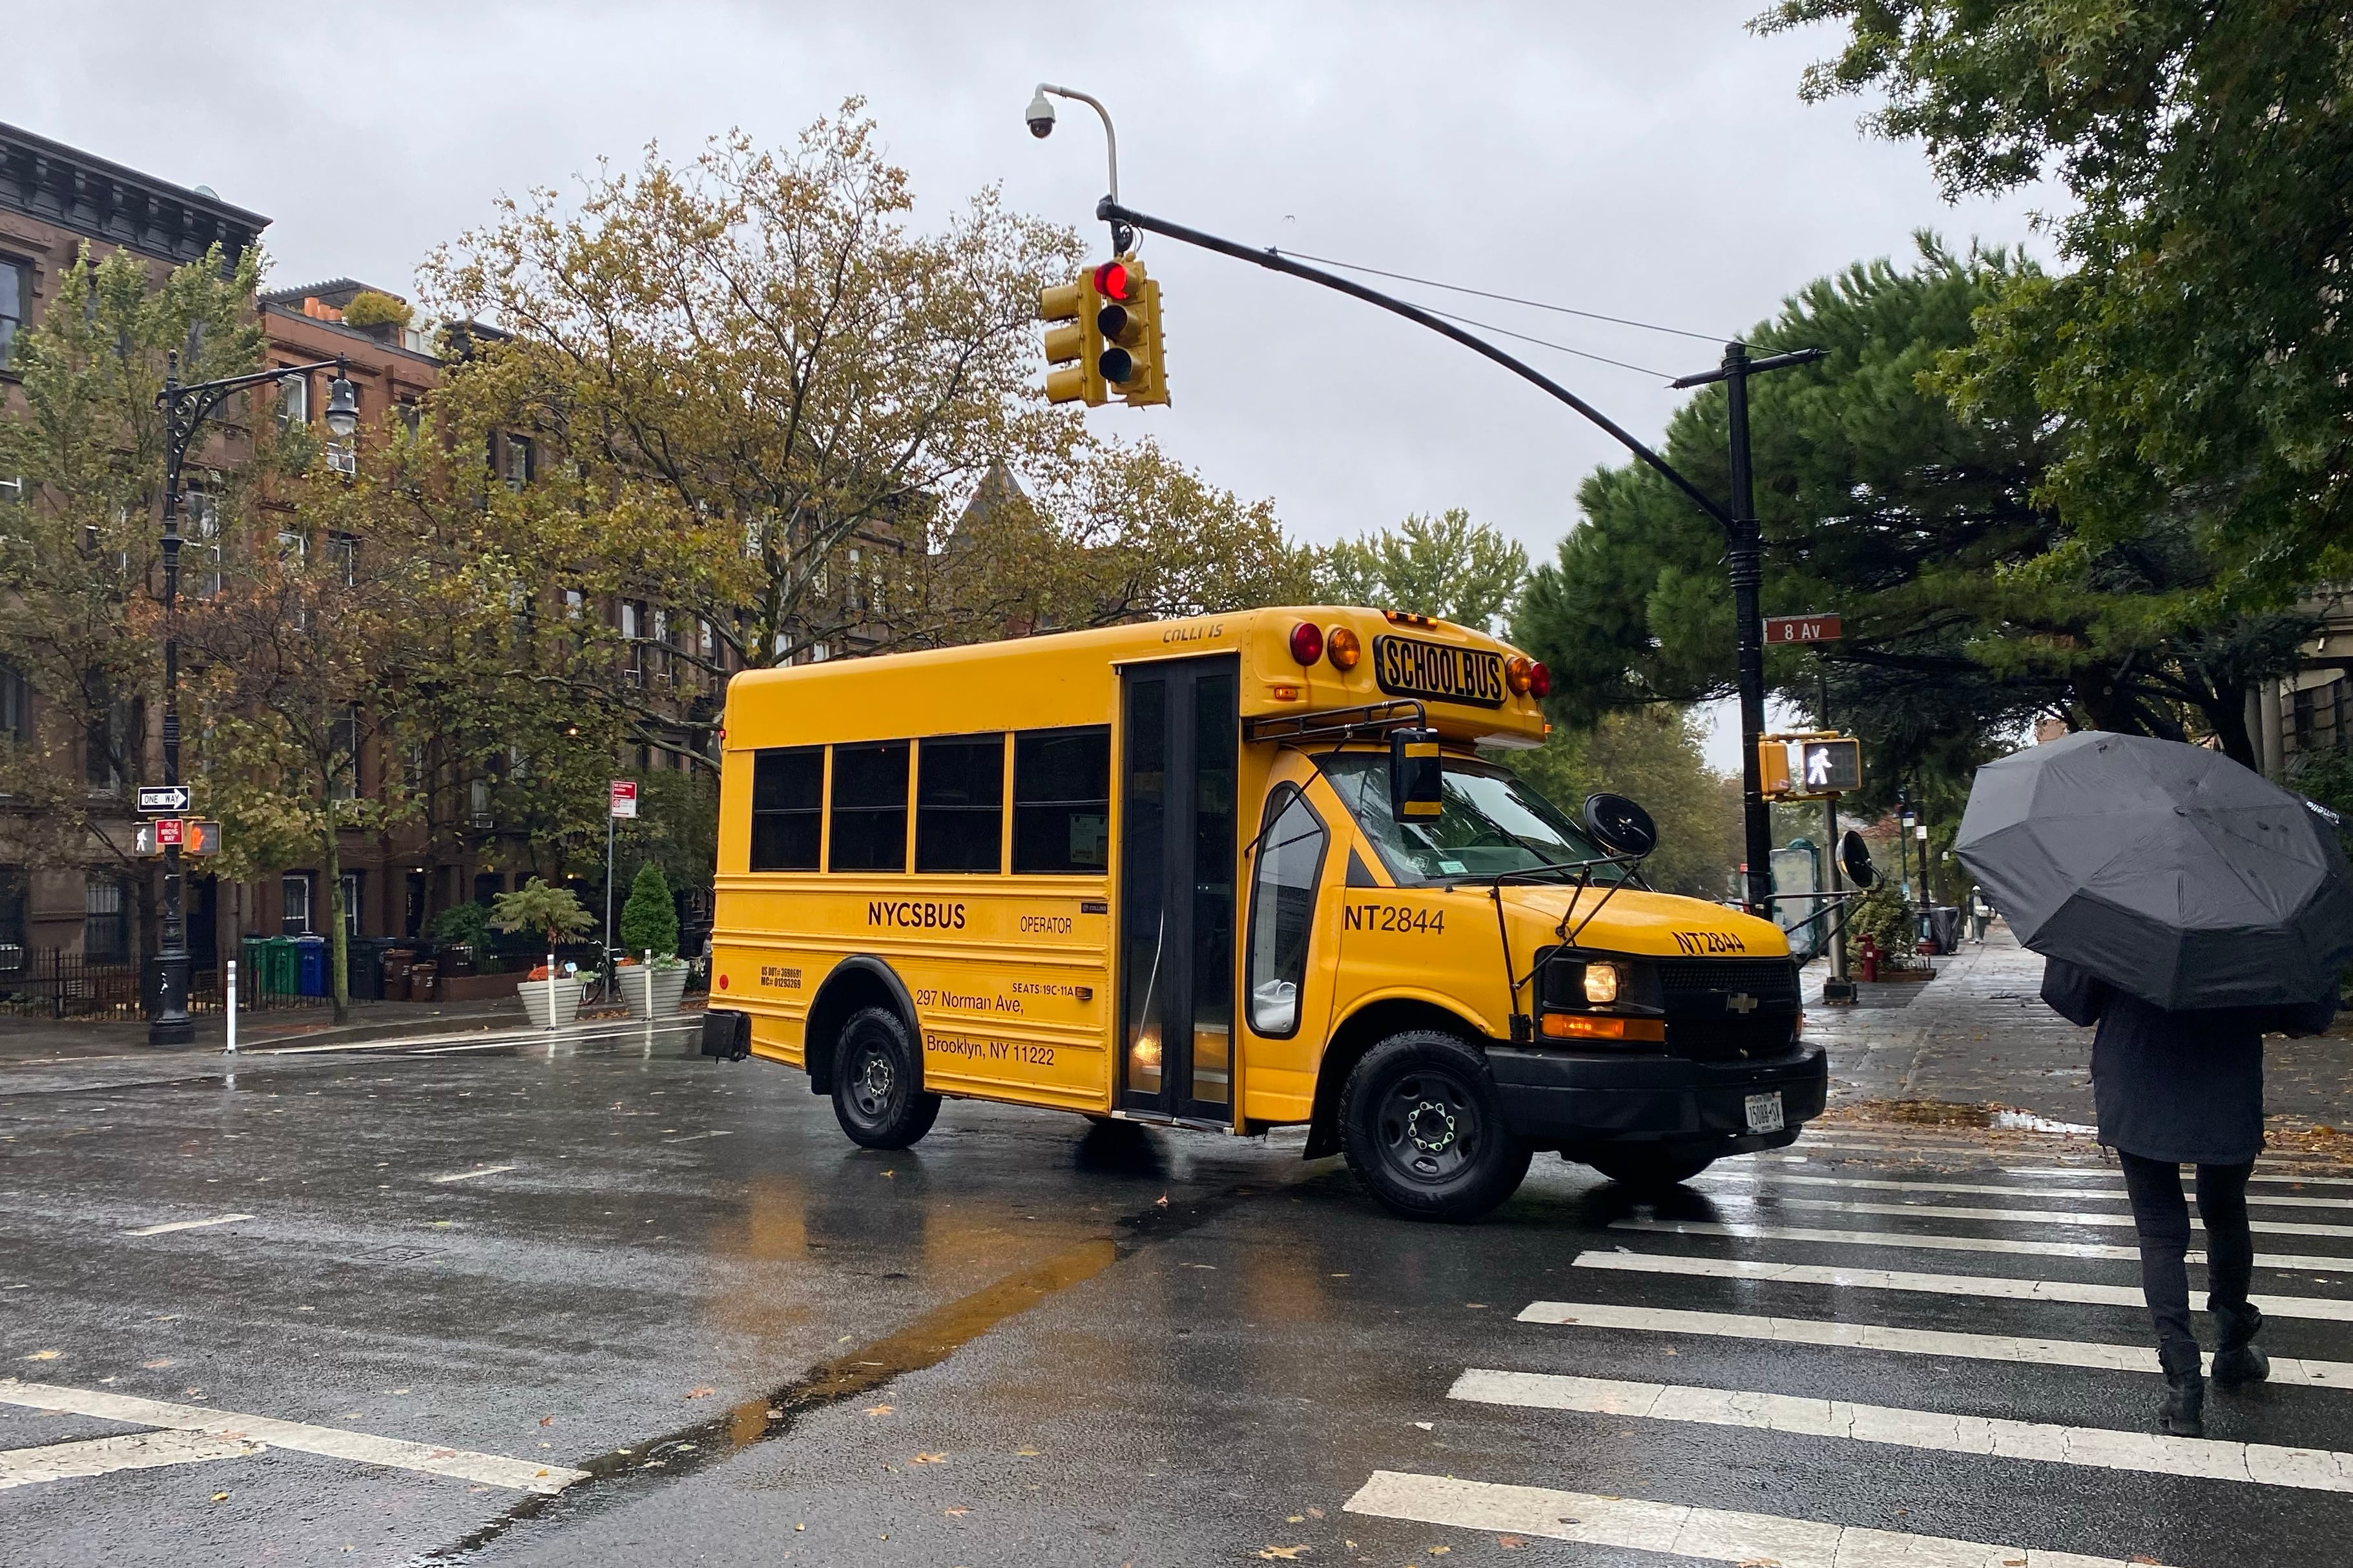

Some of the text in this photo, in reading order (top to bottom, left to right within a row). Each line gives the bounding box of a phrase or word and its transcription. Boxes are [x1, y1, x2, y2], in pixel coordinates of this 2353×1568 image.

[1785, 623, 1820, 640] 8 Av
[144, 794, 180, 804] ONE WAY
[868, 902, 966, 929] NYCSBUS
[1021, 916, 1072, 934] OPERATOR
[1344, 905, 1445, 934] NT2844
[1670, 931, 1745, 954] NT2844
[761, 966, 767, 976] US
[917, 989, 1024, 1016] 297 Norman Ave,
[927, 1035, 1055, 1066] Brooklyn, NY 11222
